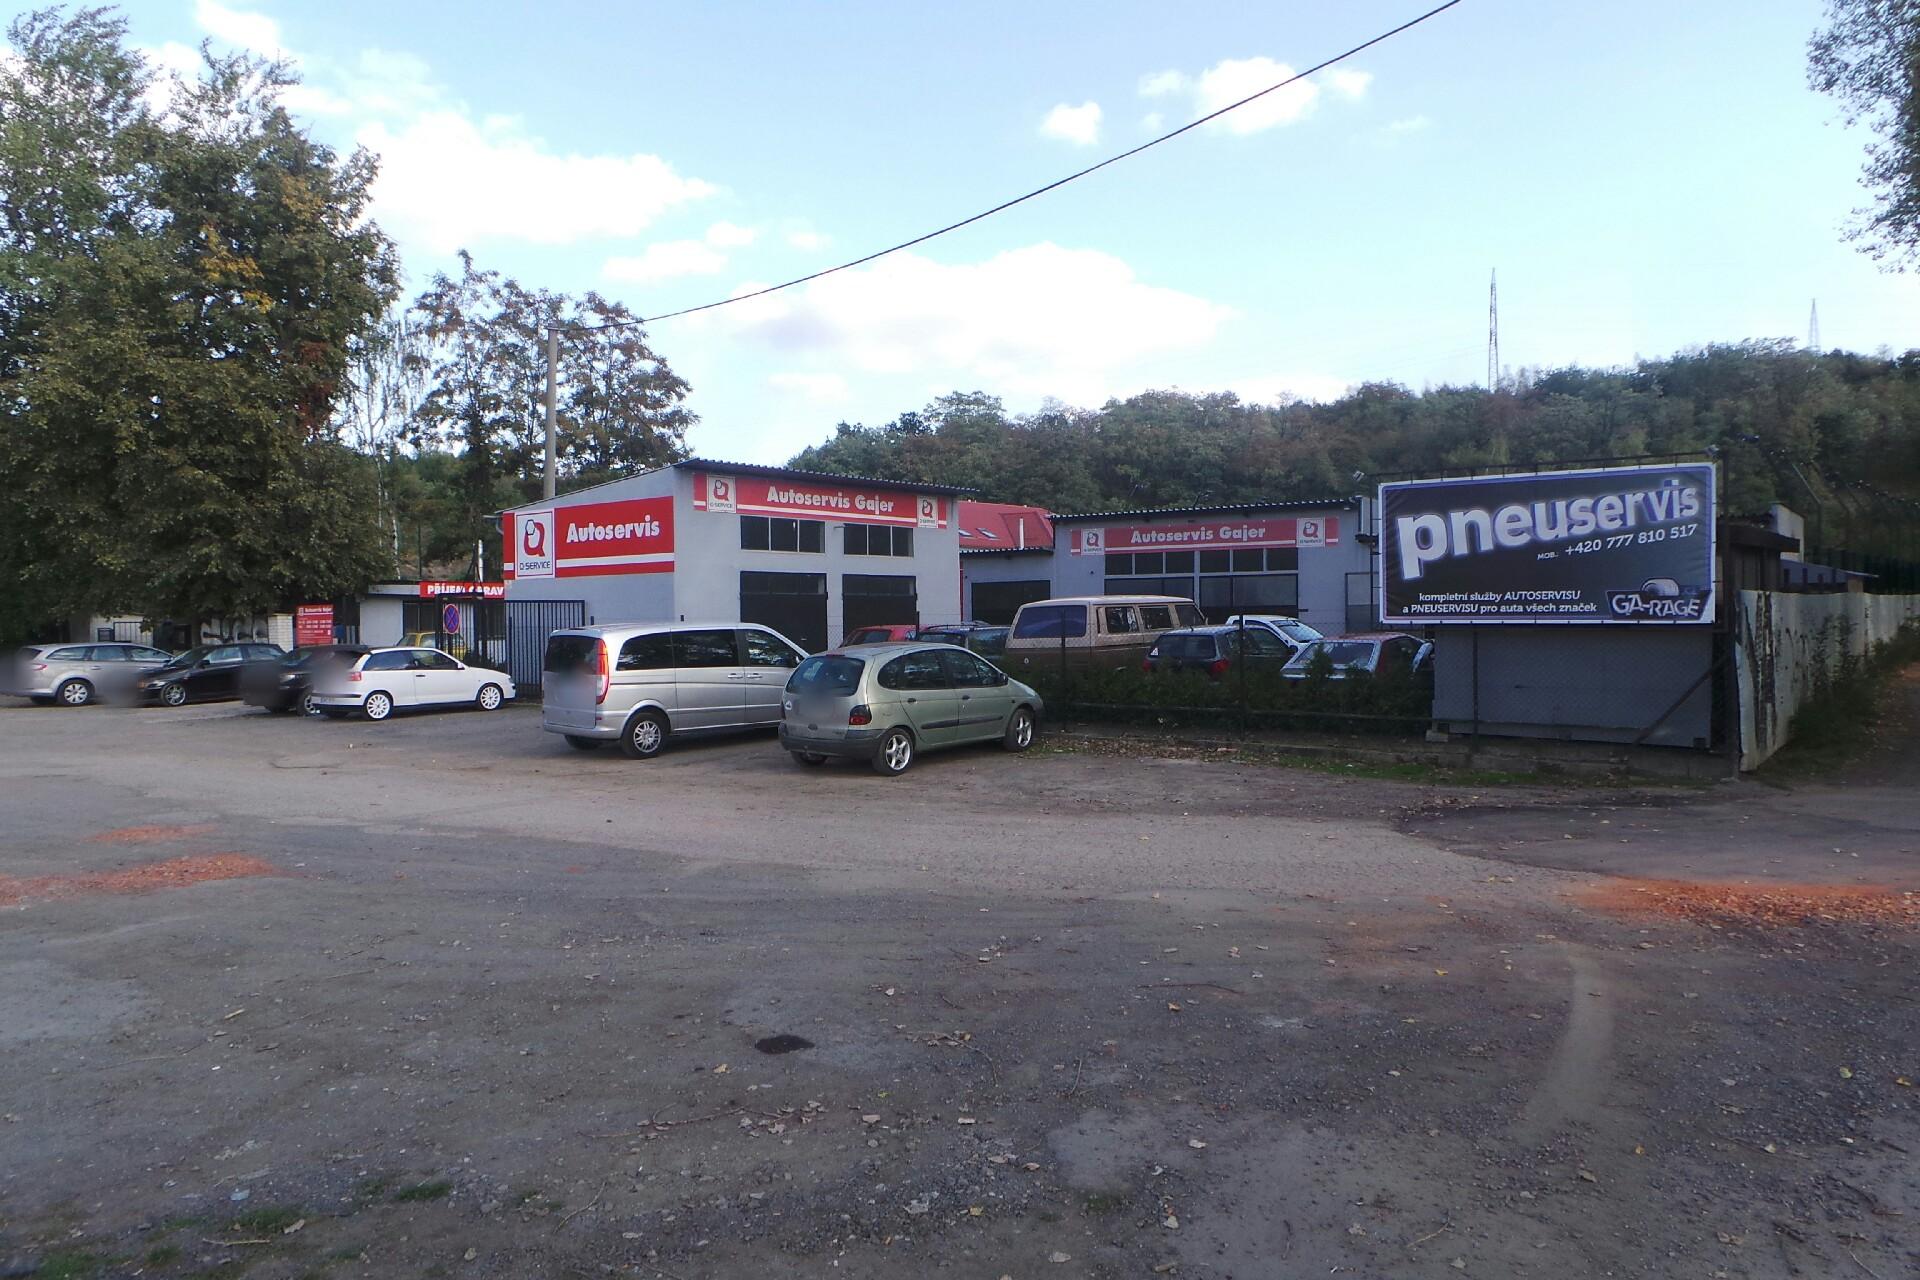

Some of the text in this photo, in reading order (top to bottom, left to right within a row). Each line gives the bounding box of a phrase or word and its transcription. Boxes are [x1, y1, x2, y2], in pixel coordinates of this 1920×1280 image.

[767, 486, 895, 516] Autoservis Gajer
[566, 514, 660, 543] Autoservis
[1131, 523, 1266, 543] Autoservis Gajer
[1397, 479, 1700, 580] pneuservis
[1565, 540, 1602, 556] +420
[1606, 534, 1634, 549] 777
[1638, 529, 1665, 544] 810
[1670, 524, 1697, 540] 517
[1411, 604, 1478, 613] PNEUSERVISU
[1480, 605, 1498, 614] pro
[1525, 603, 1556, 612] všech
[1559, 602, 1597, 612] značek
[1419, 590, 1581, 603] kompletní služby AUTOSERVISU
